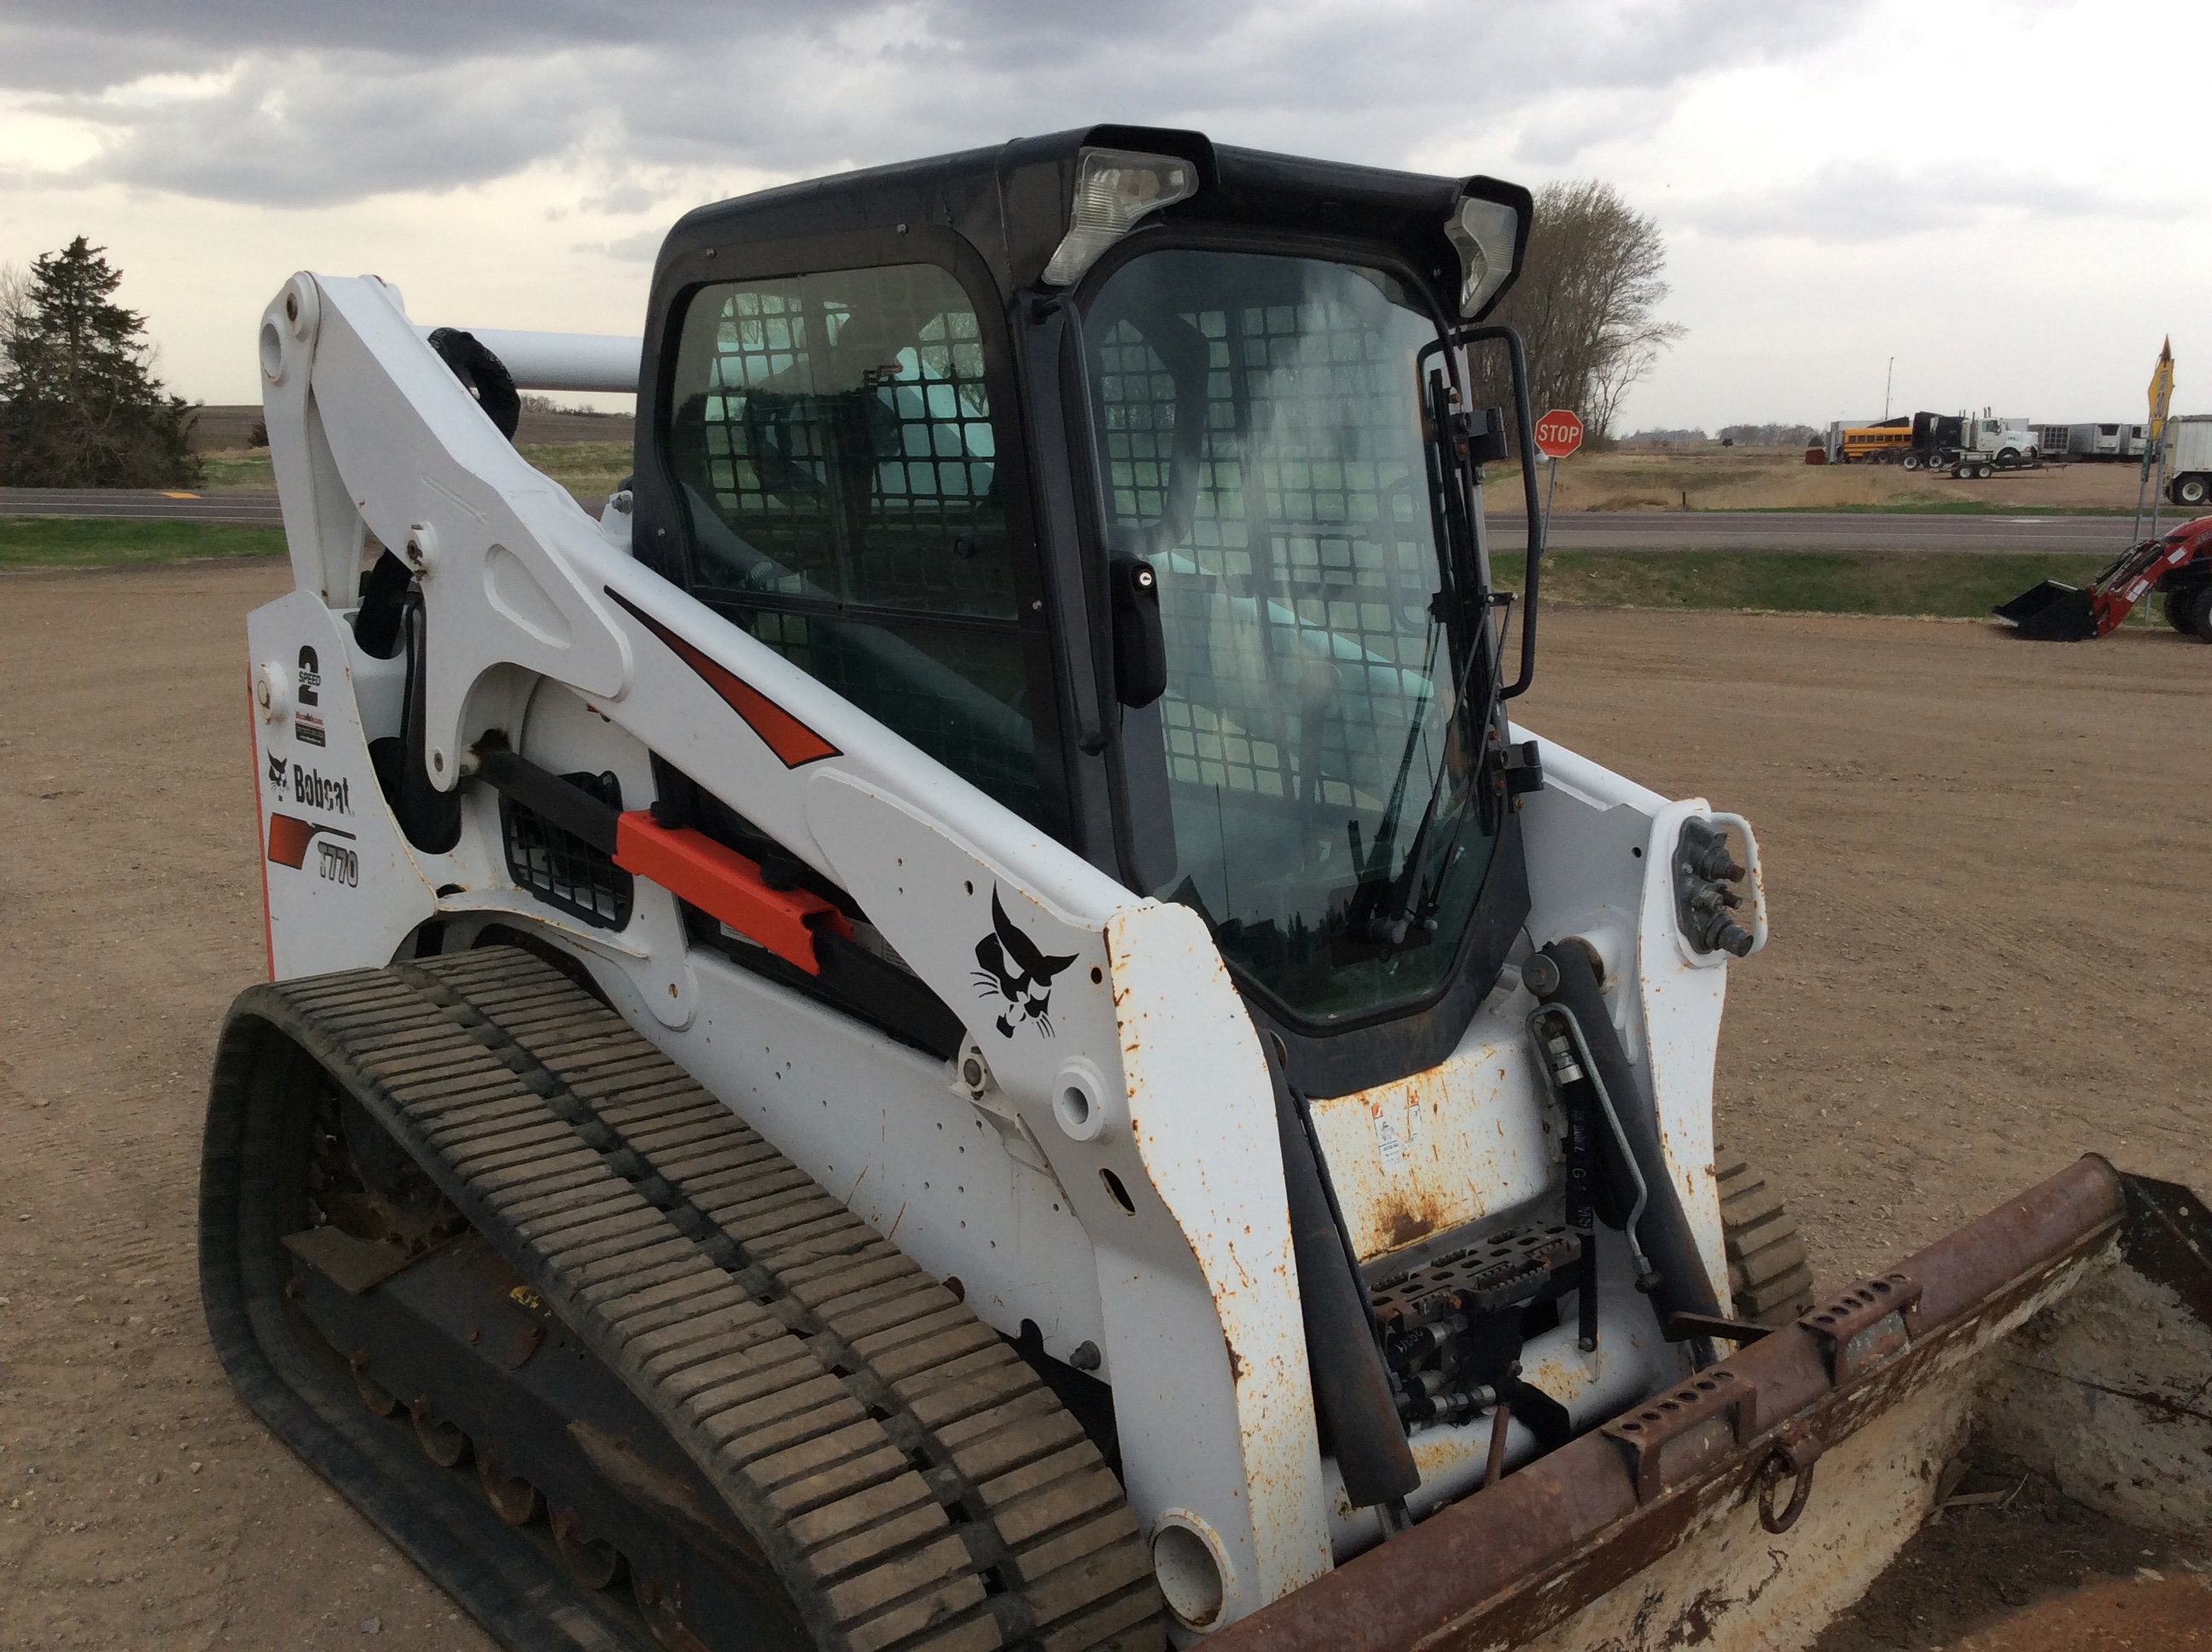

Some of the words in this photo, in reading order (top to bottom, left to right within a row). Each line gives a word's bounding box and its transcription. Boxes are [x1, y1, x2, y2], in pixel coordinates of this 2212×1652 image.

[1539, 423, 1580, 444] STOP
[299, 671, 322, 687] SPEED
[293, 764, 351, 815] Bobcat
[317, 841, 358, 888] T770
